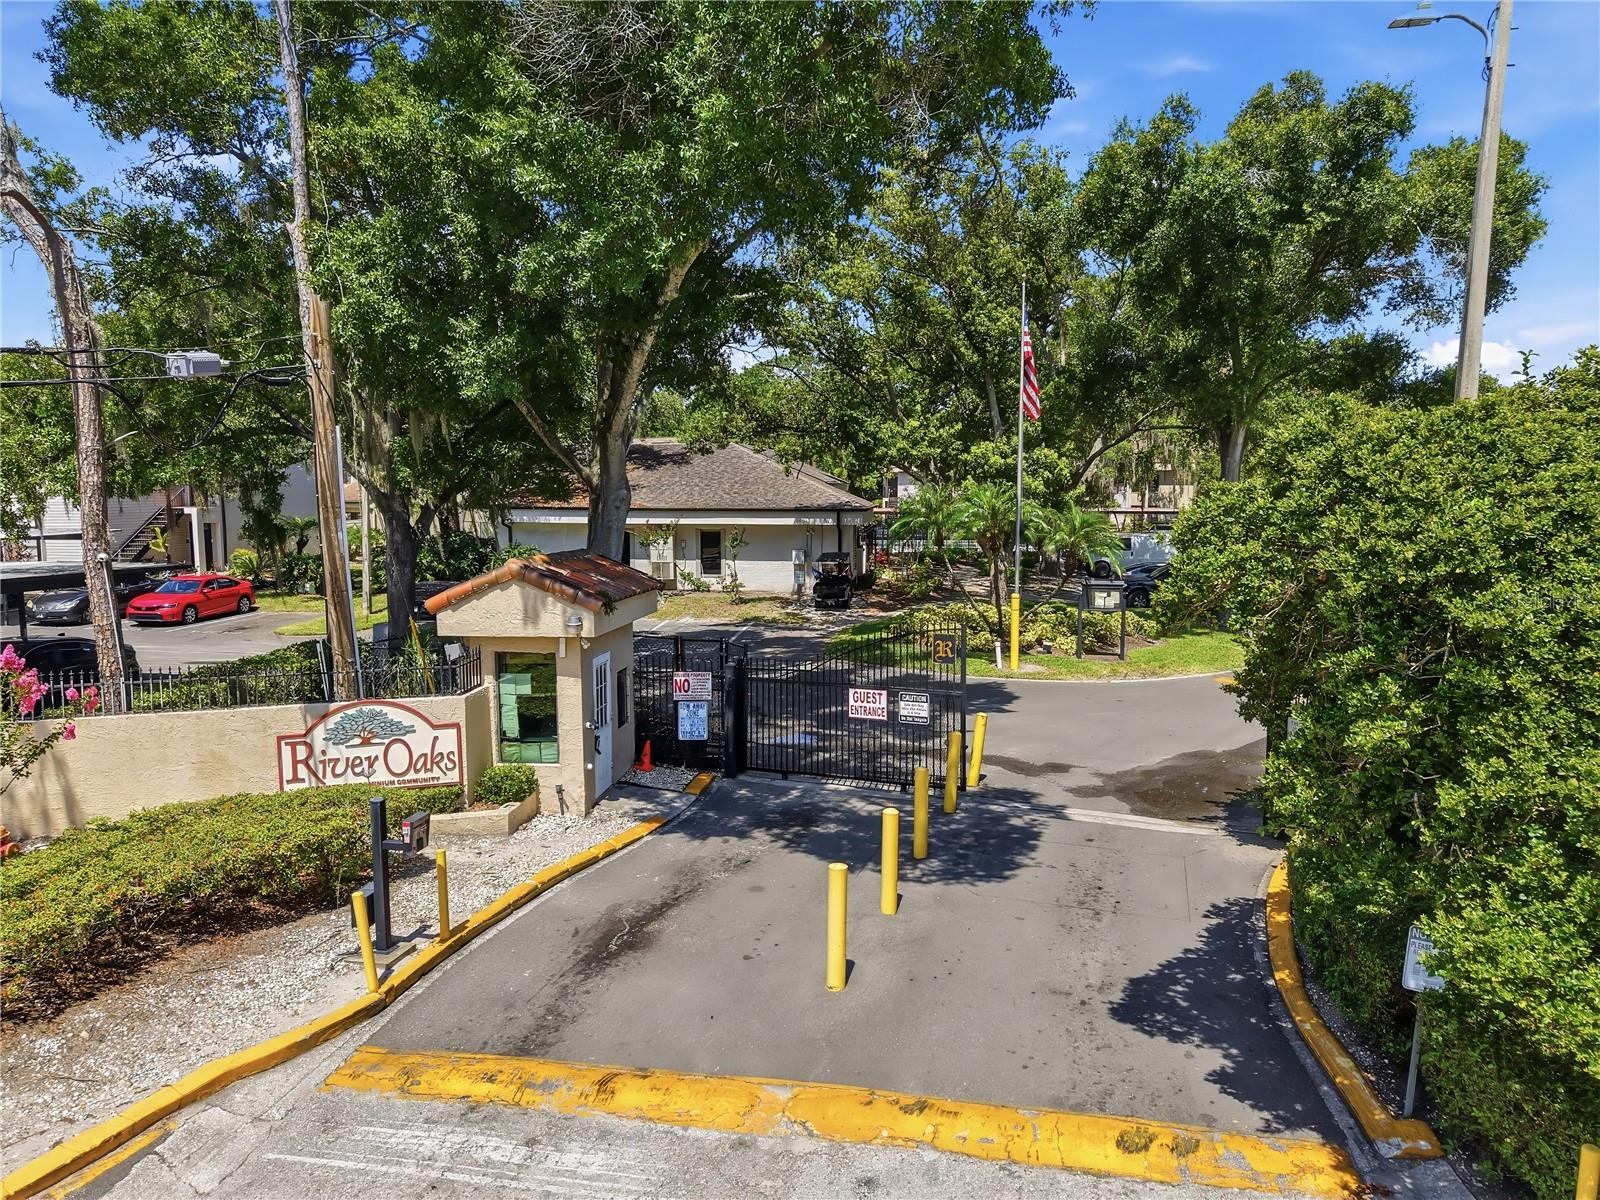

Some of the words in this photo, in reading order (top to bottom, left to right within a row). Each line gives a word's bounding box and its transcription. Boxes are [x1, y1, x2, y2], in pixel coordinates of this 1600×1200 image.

[935, 640, 954, 662] R
[674, 678, 690, 693] NO
[853, 691, 883, 704] GUEST
[850, 705, 886, 717] ENTRANCE
[285, 740, 379, 785] River
[383, 736, 457, 779] Oaks
[397, 776, 441, 787] COMMUNITY
[1410, 941, 1433, 952] PLEASE
